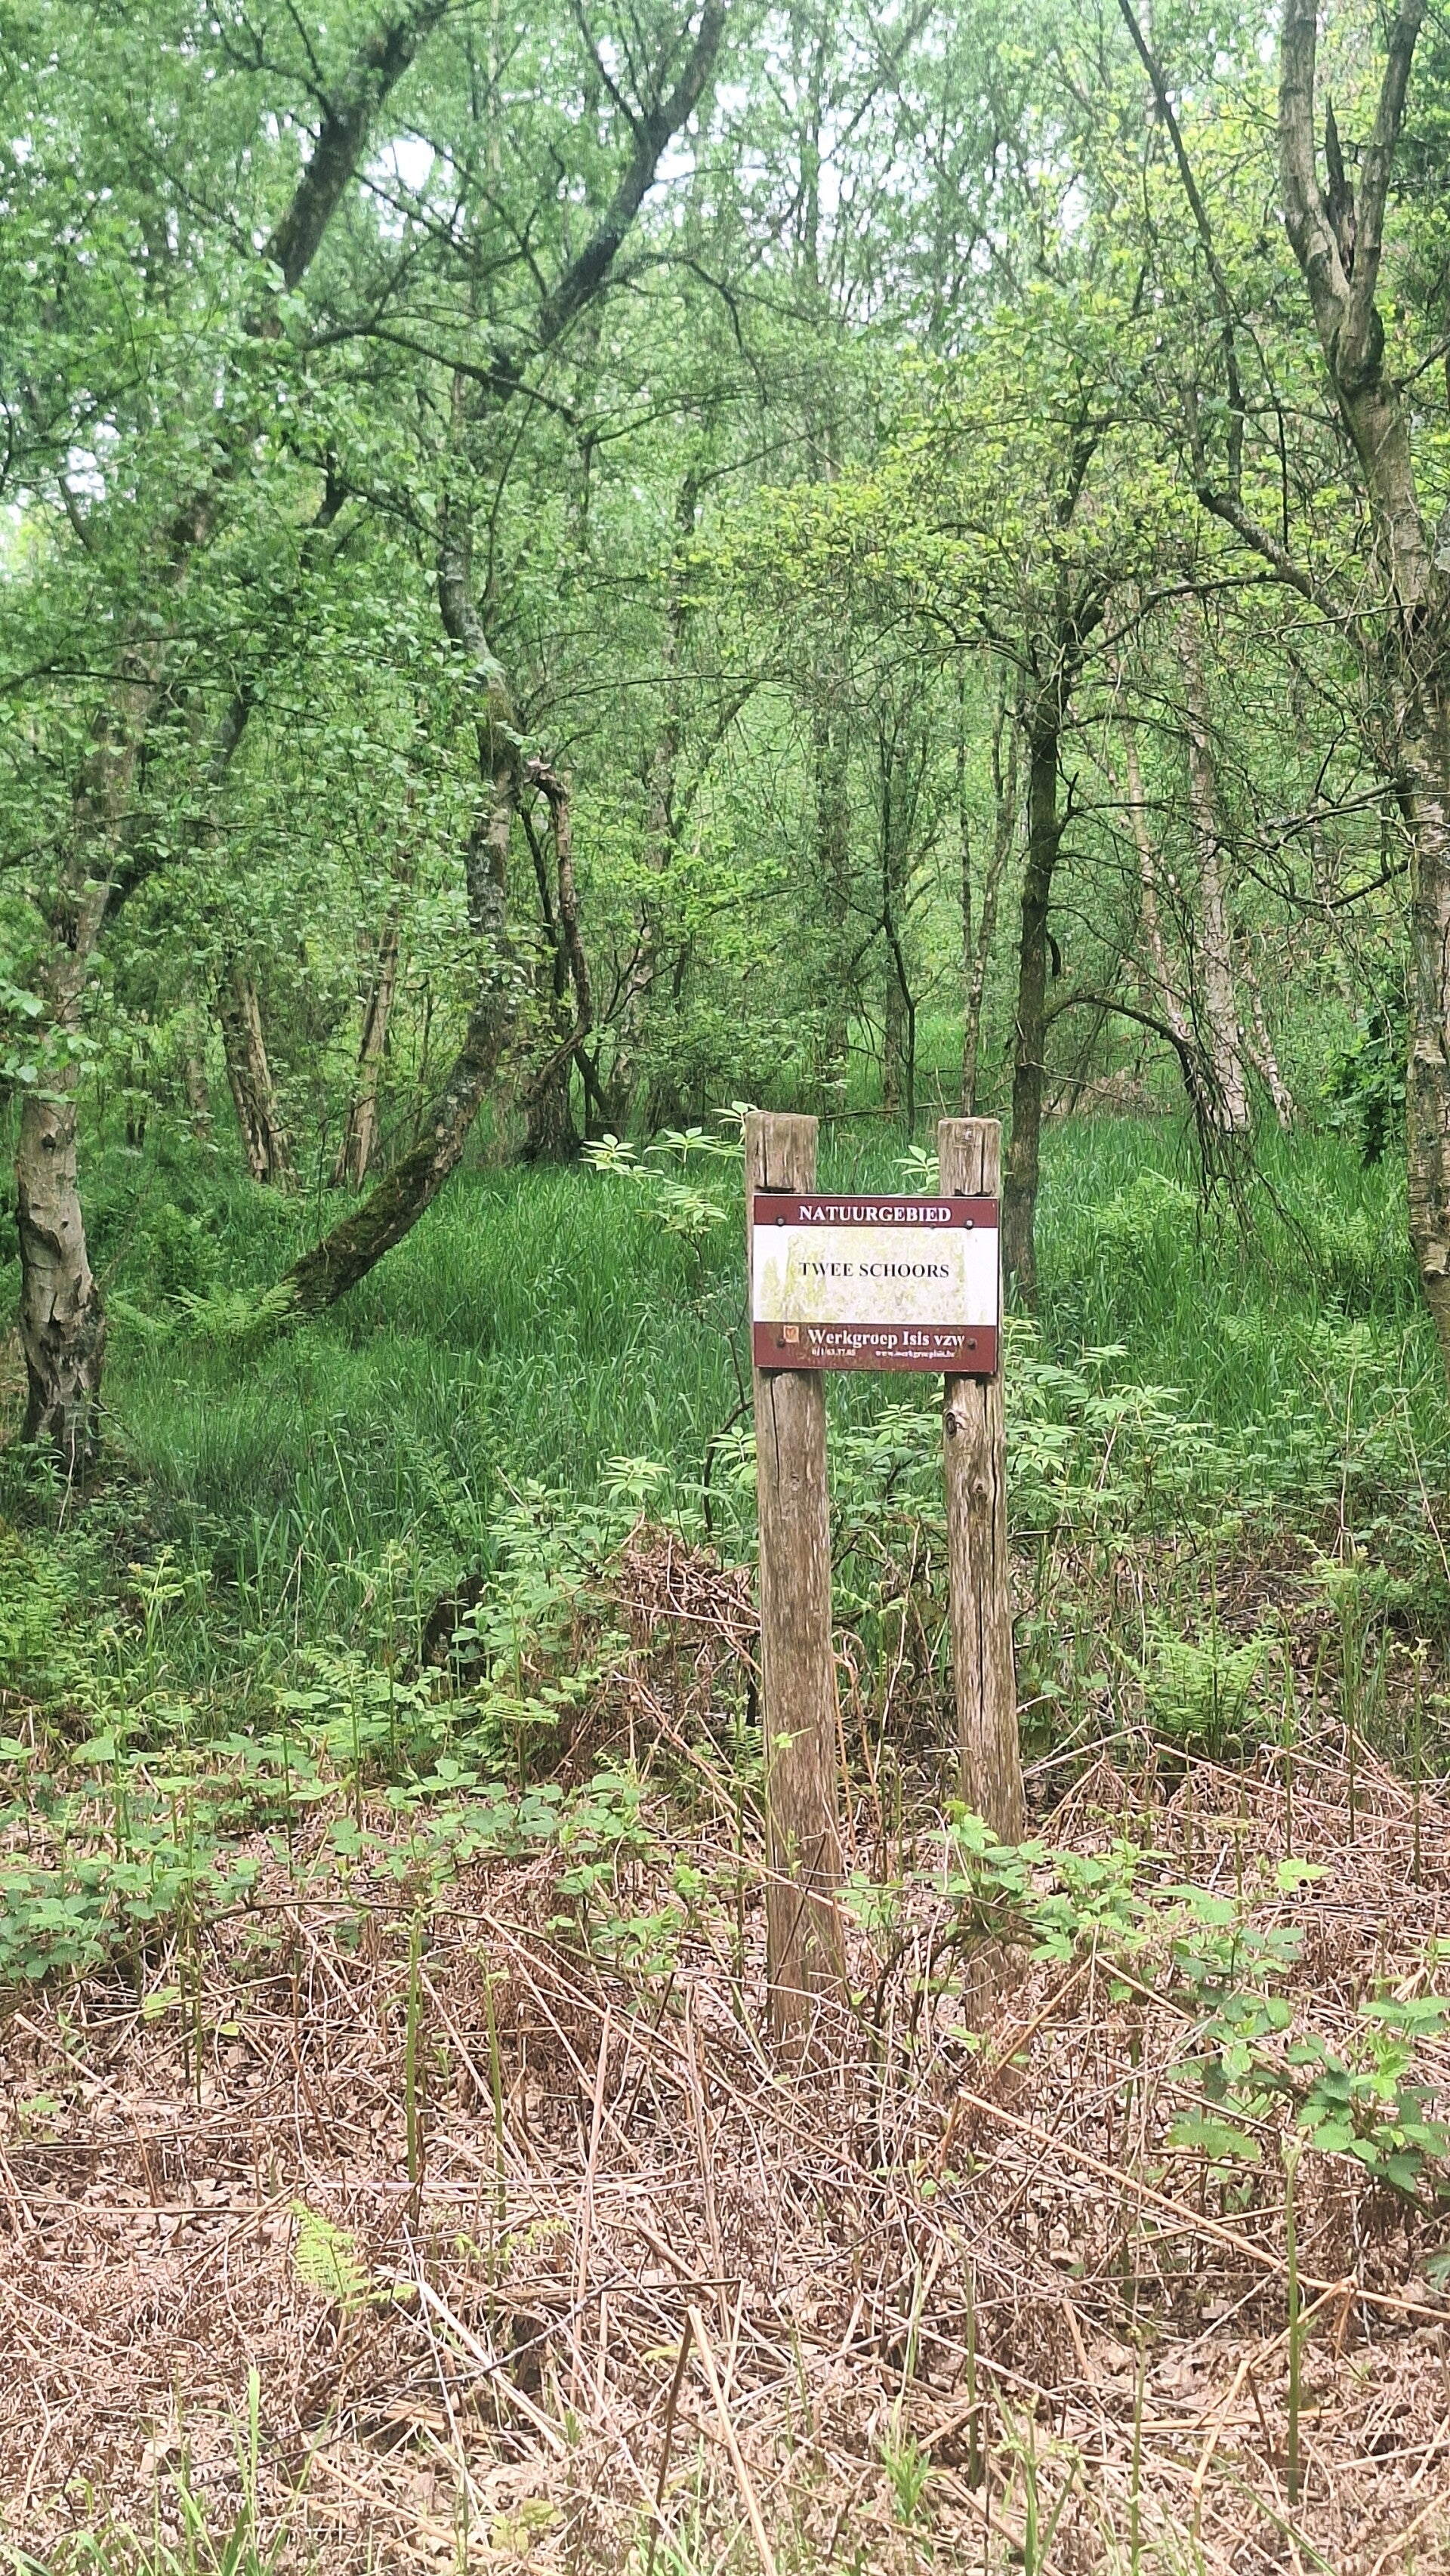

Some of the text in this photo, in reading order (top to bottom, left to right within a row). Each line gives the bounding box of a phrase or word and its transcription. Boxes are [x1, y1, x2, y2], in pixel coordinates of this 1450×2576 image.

[799, 1205, 952, 1222] NATUURGEBIED
[799, 1262, 949, 1278] TWEE SCHOORS
[808, 1328, 965, 1348] Werkgroep Isis vzw
